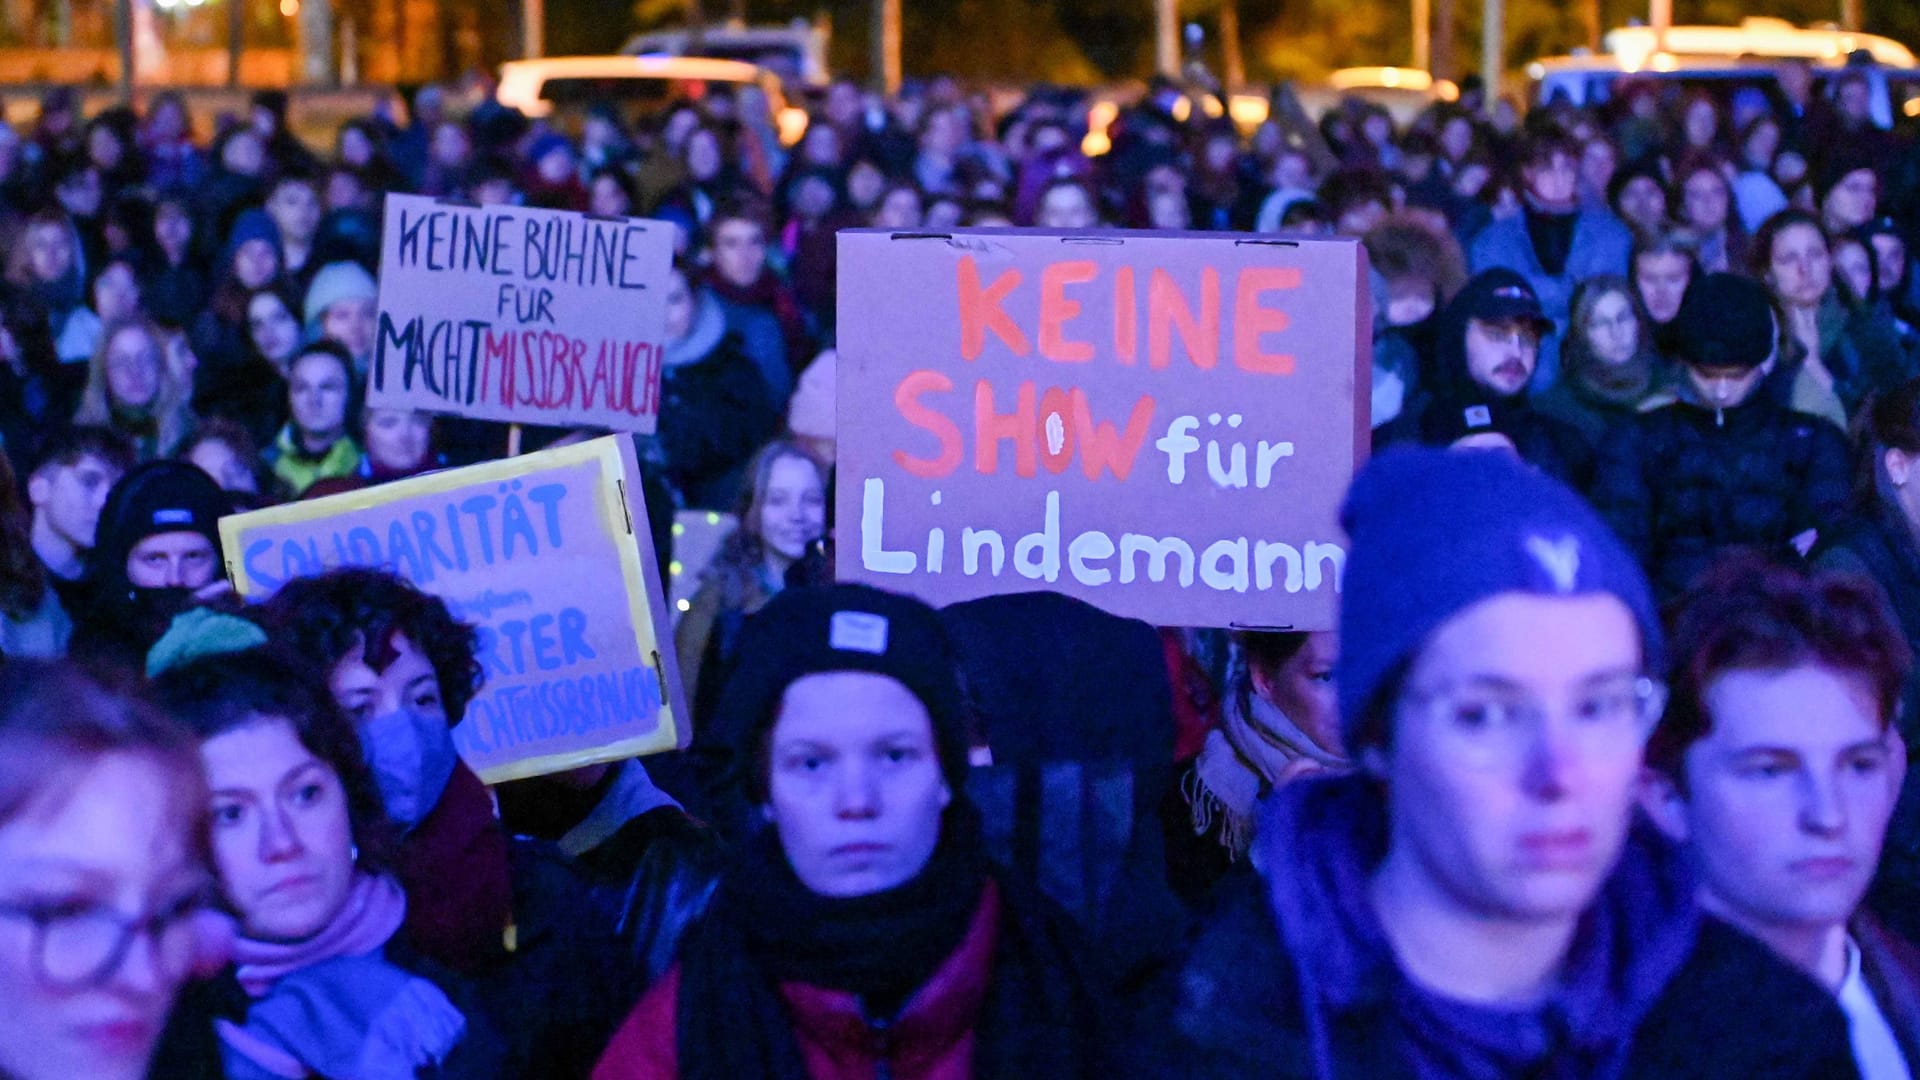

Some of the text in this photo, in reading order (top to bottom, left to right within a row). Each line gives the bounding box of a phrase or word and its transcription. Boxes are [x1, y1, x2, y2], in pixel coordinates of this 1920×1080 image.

[399, 208, 648, 290] KEINE BÜHNE
[497, 283, 556, 325] FÜR
[374, 310, 664, 417] MACHTMISSBRAUCH
[956, 254, 1303, 377] KEINE
[891, 368, 1294, 489] SHOW für
[860, 477, 1347, 594] Lindemann
